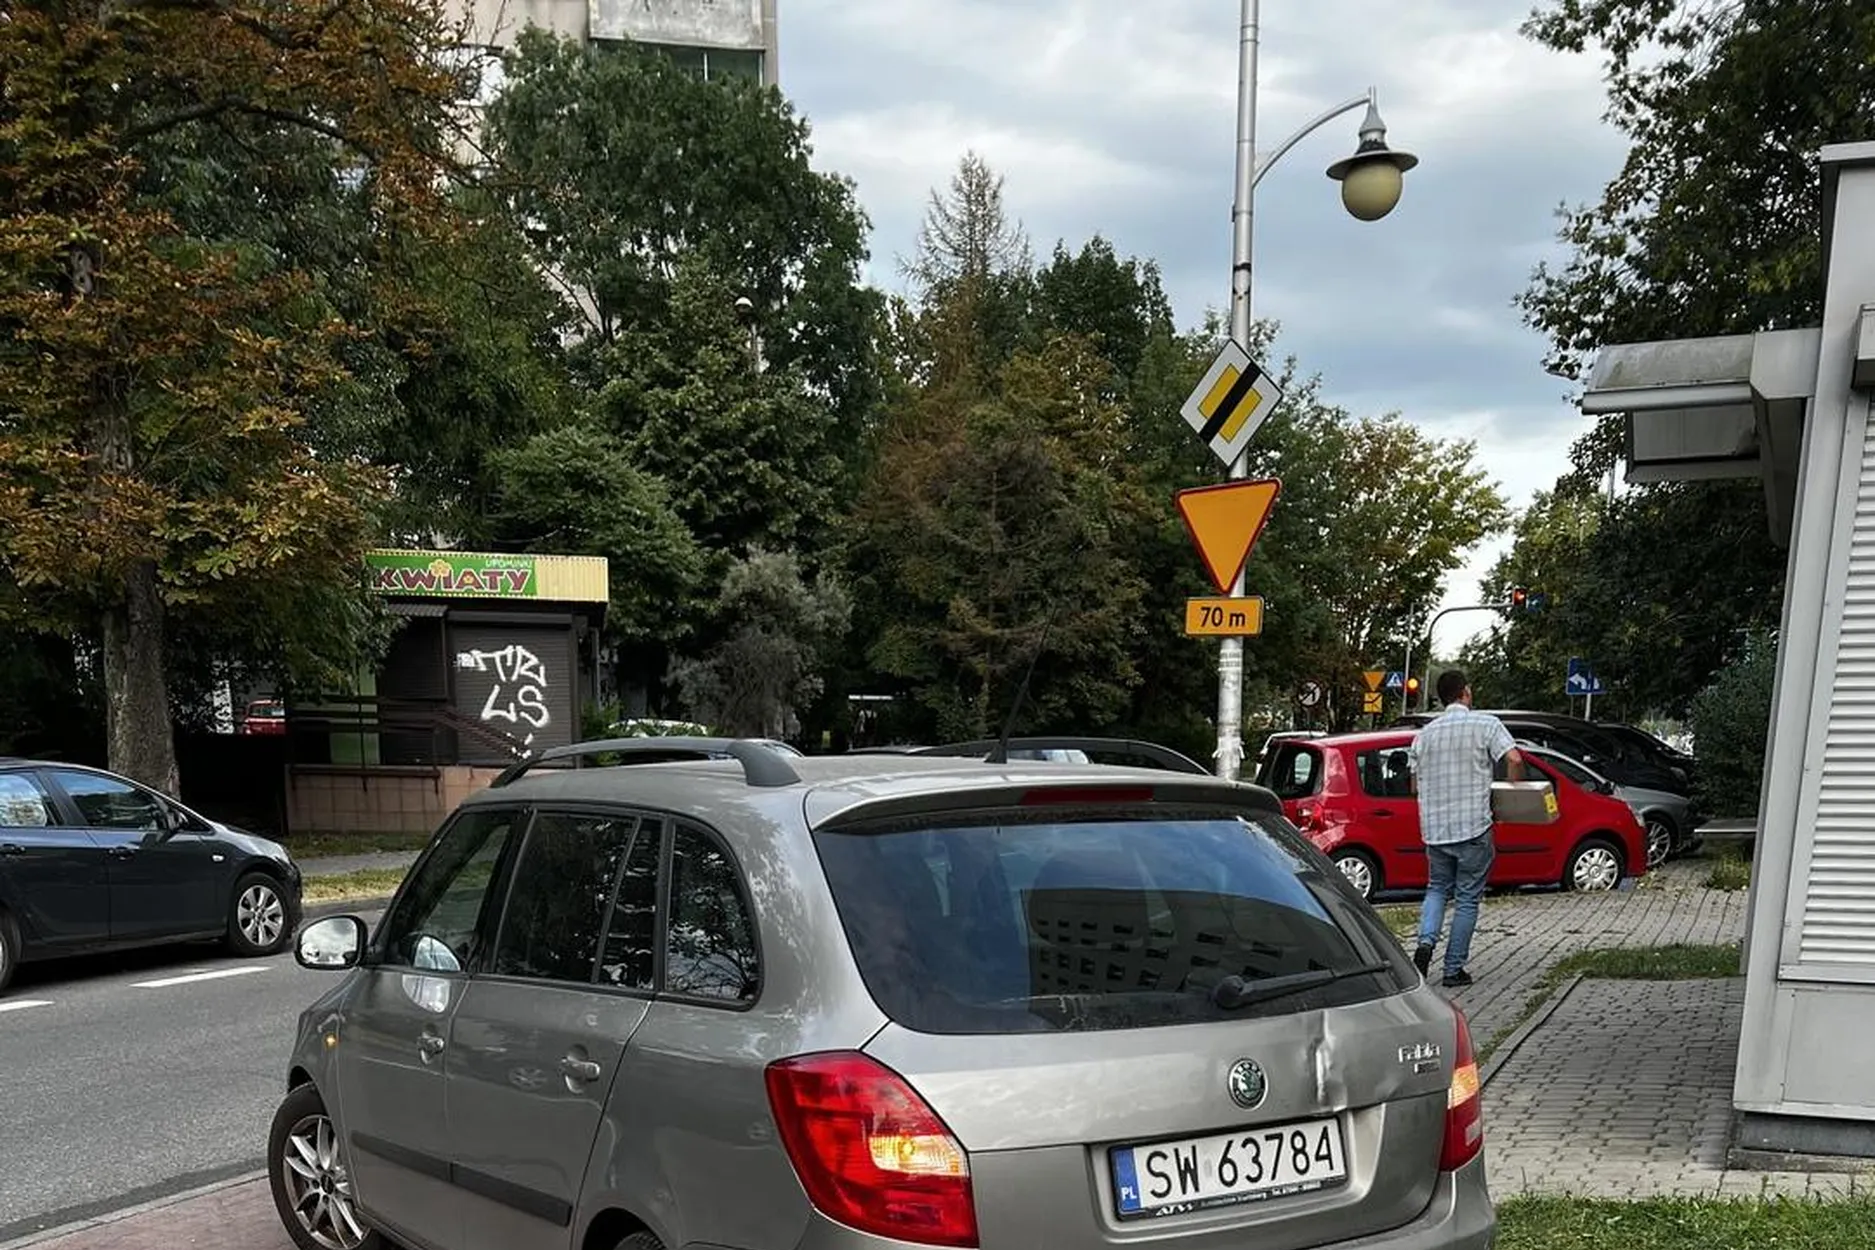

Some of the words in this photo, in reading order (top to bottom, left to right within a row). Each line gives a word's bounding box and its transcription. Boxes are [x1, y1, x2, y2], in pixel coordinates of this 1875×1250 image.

[371, 567, 532, 593] KWIATY
[1200, 607, 1224, 628] 70
[1229, 612, 1246, 627] m
[1146, 1145, 1201, 1199] SW
[1217, 1125, 1335, 1188] 63784
[1121, 1186, 1138, 1201] PL
